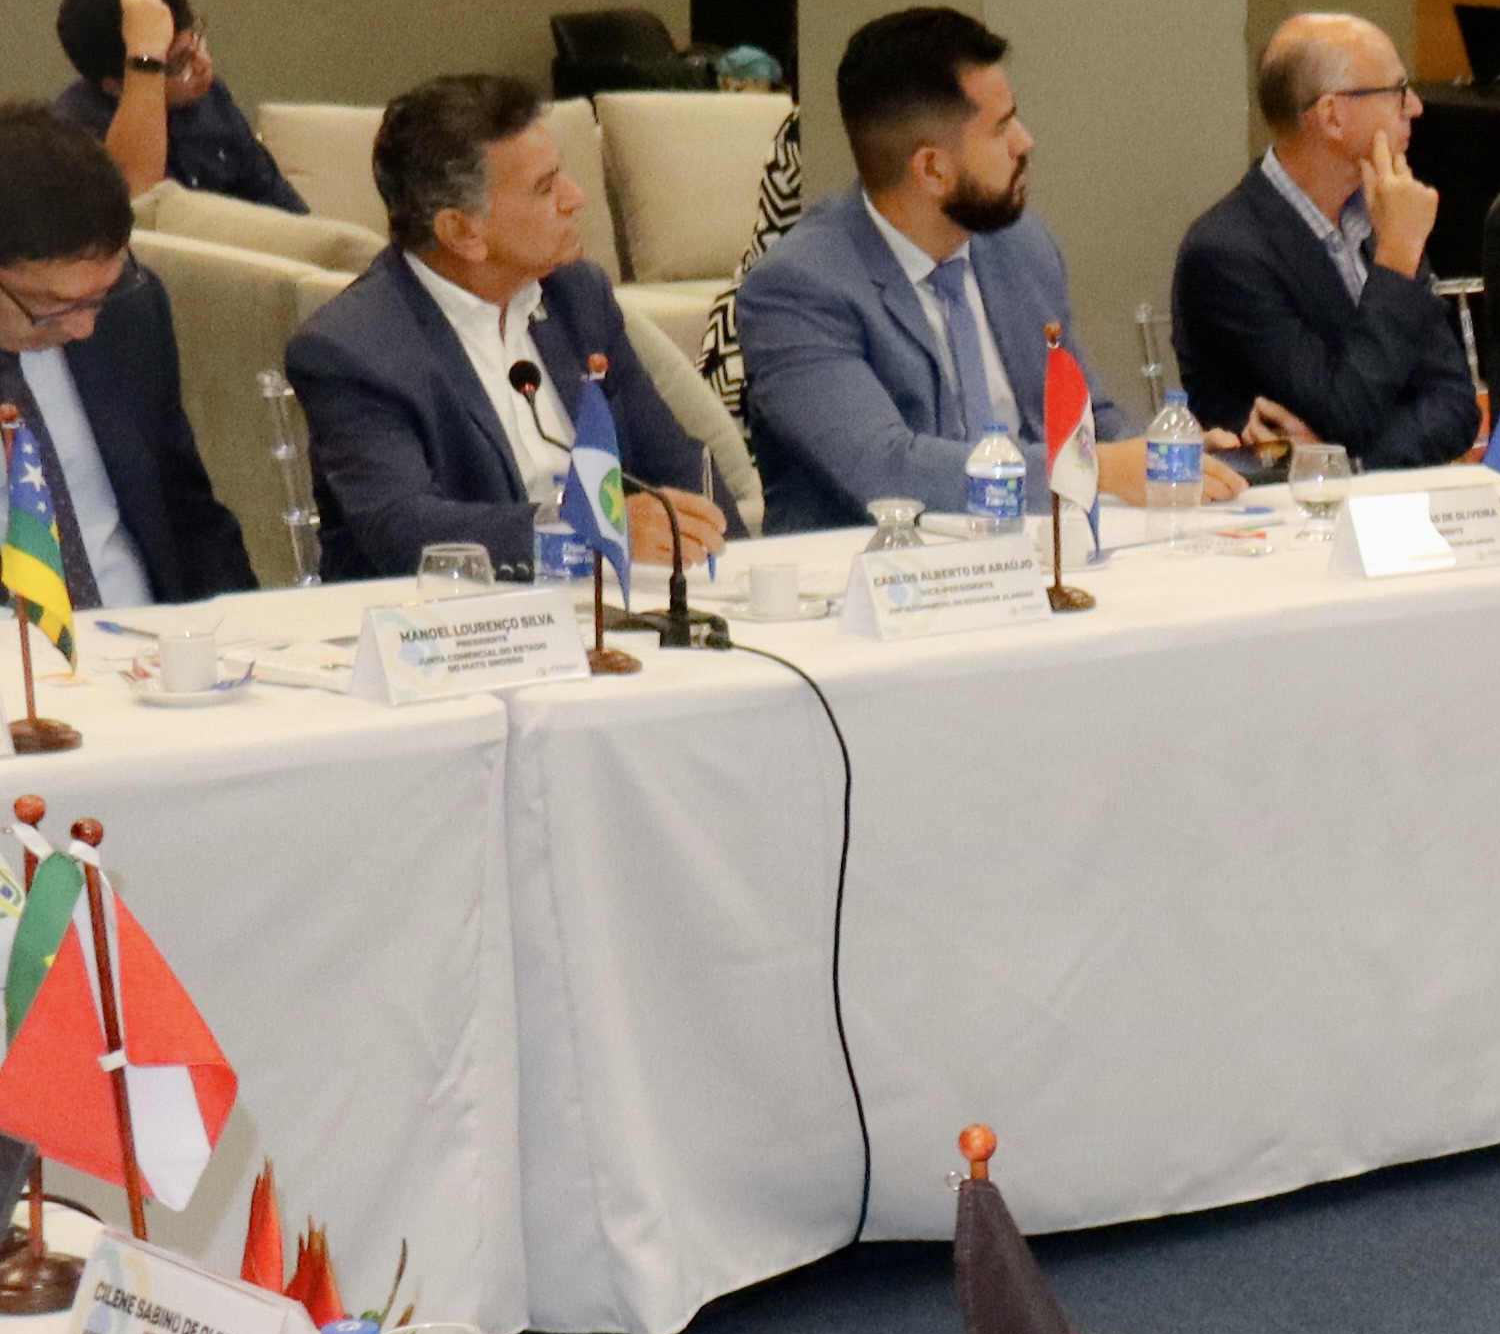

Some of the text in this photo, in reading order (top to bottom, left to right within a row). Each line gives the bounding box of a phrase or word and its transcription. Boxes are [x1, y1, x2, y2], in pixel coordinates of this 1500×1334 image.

[1442, 511, 1455, 523] DE
[1455, 508, 1498, 521] OLIVEIRA
[873, 559, 1034, 588] CARLOS ALBERTO DE ARAÚJO
[400, 612, 556, 643] MANOEL LOURENÇO SILVA
[447, 649, 498, 664] COMERCIAL
[499, 648, 512, 658] DO
[513, 641, 548, 655] ESTADO
[455, 634, 508, 649] PRESIDENTE
[93, 1281, 138, 1315] CILENE
[137, 1297, 182, 1334] SABINO
